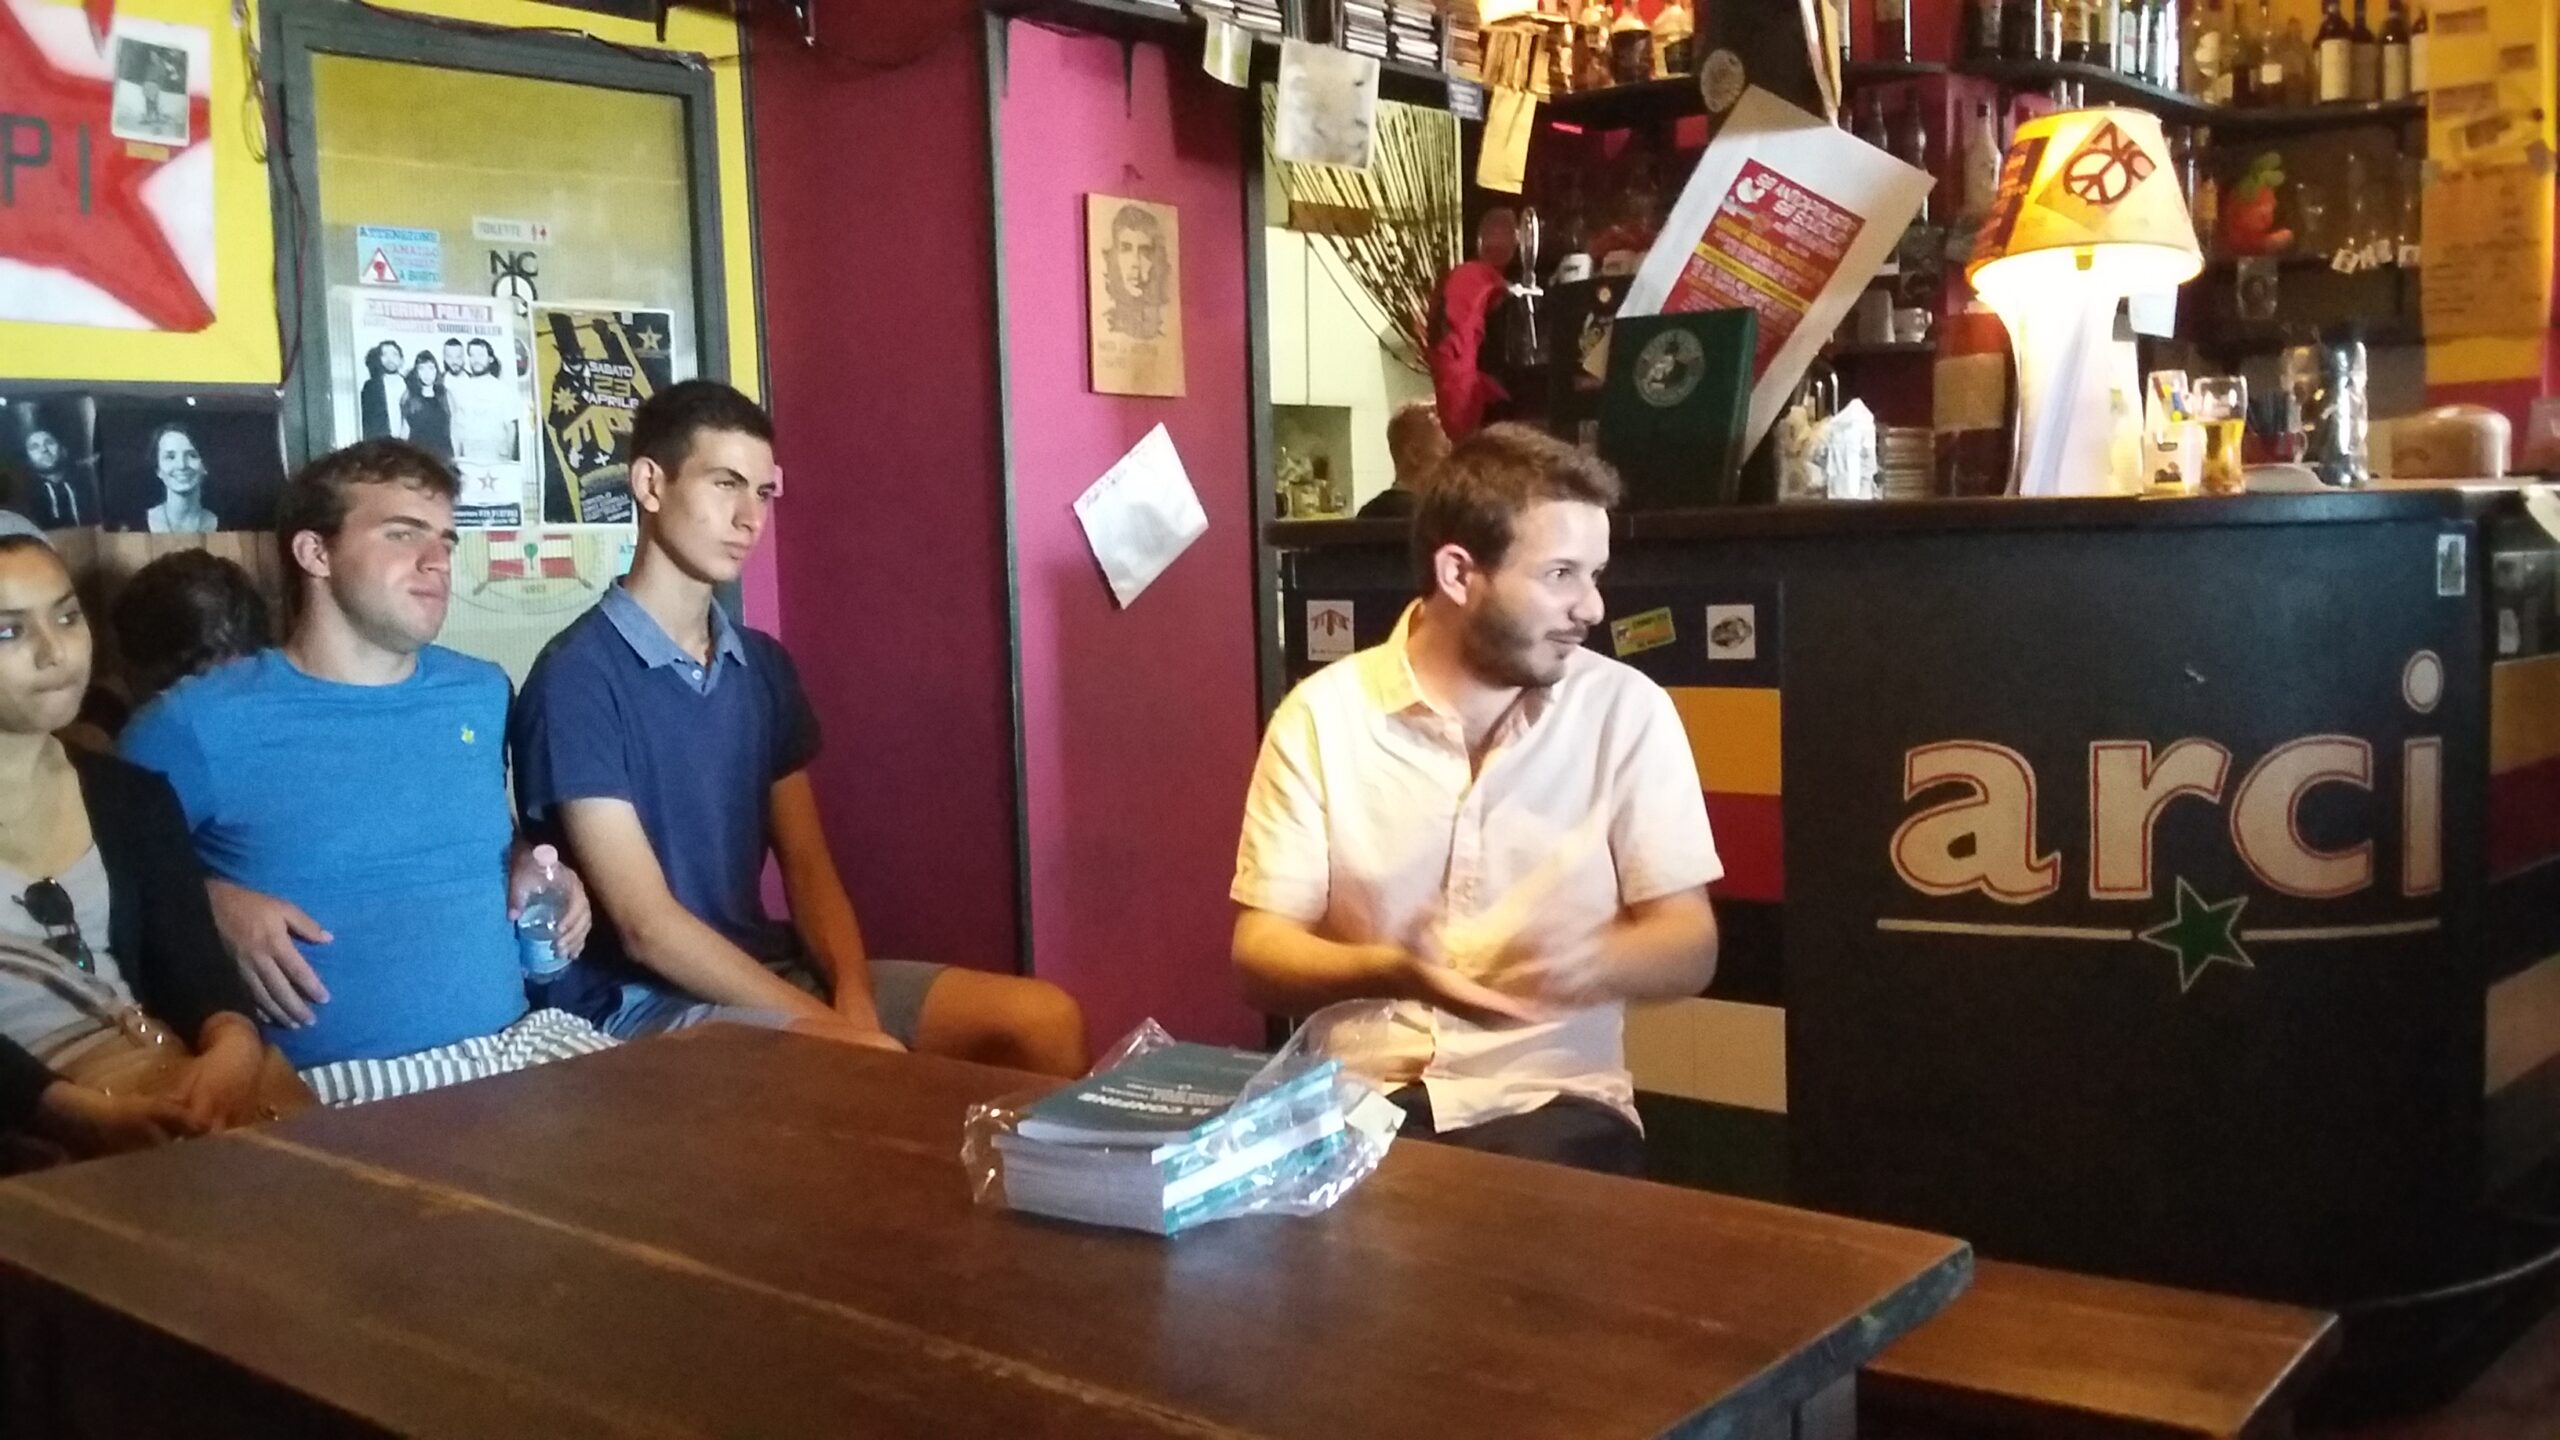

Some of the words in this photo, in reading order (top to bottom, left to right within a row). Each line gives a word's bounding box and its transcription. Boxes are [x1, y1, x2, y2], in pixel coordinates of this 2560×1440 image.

[589, 361, 633, 377] SABATO
[593, 375, 631, 396] 23
[1889, 649, 2444, 904] arci
